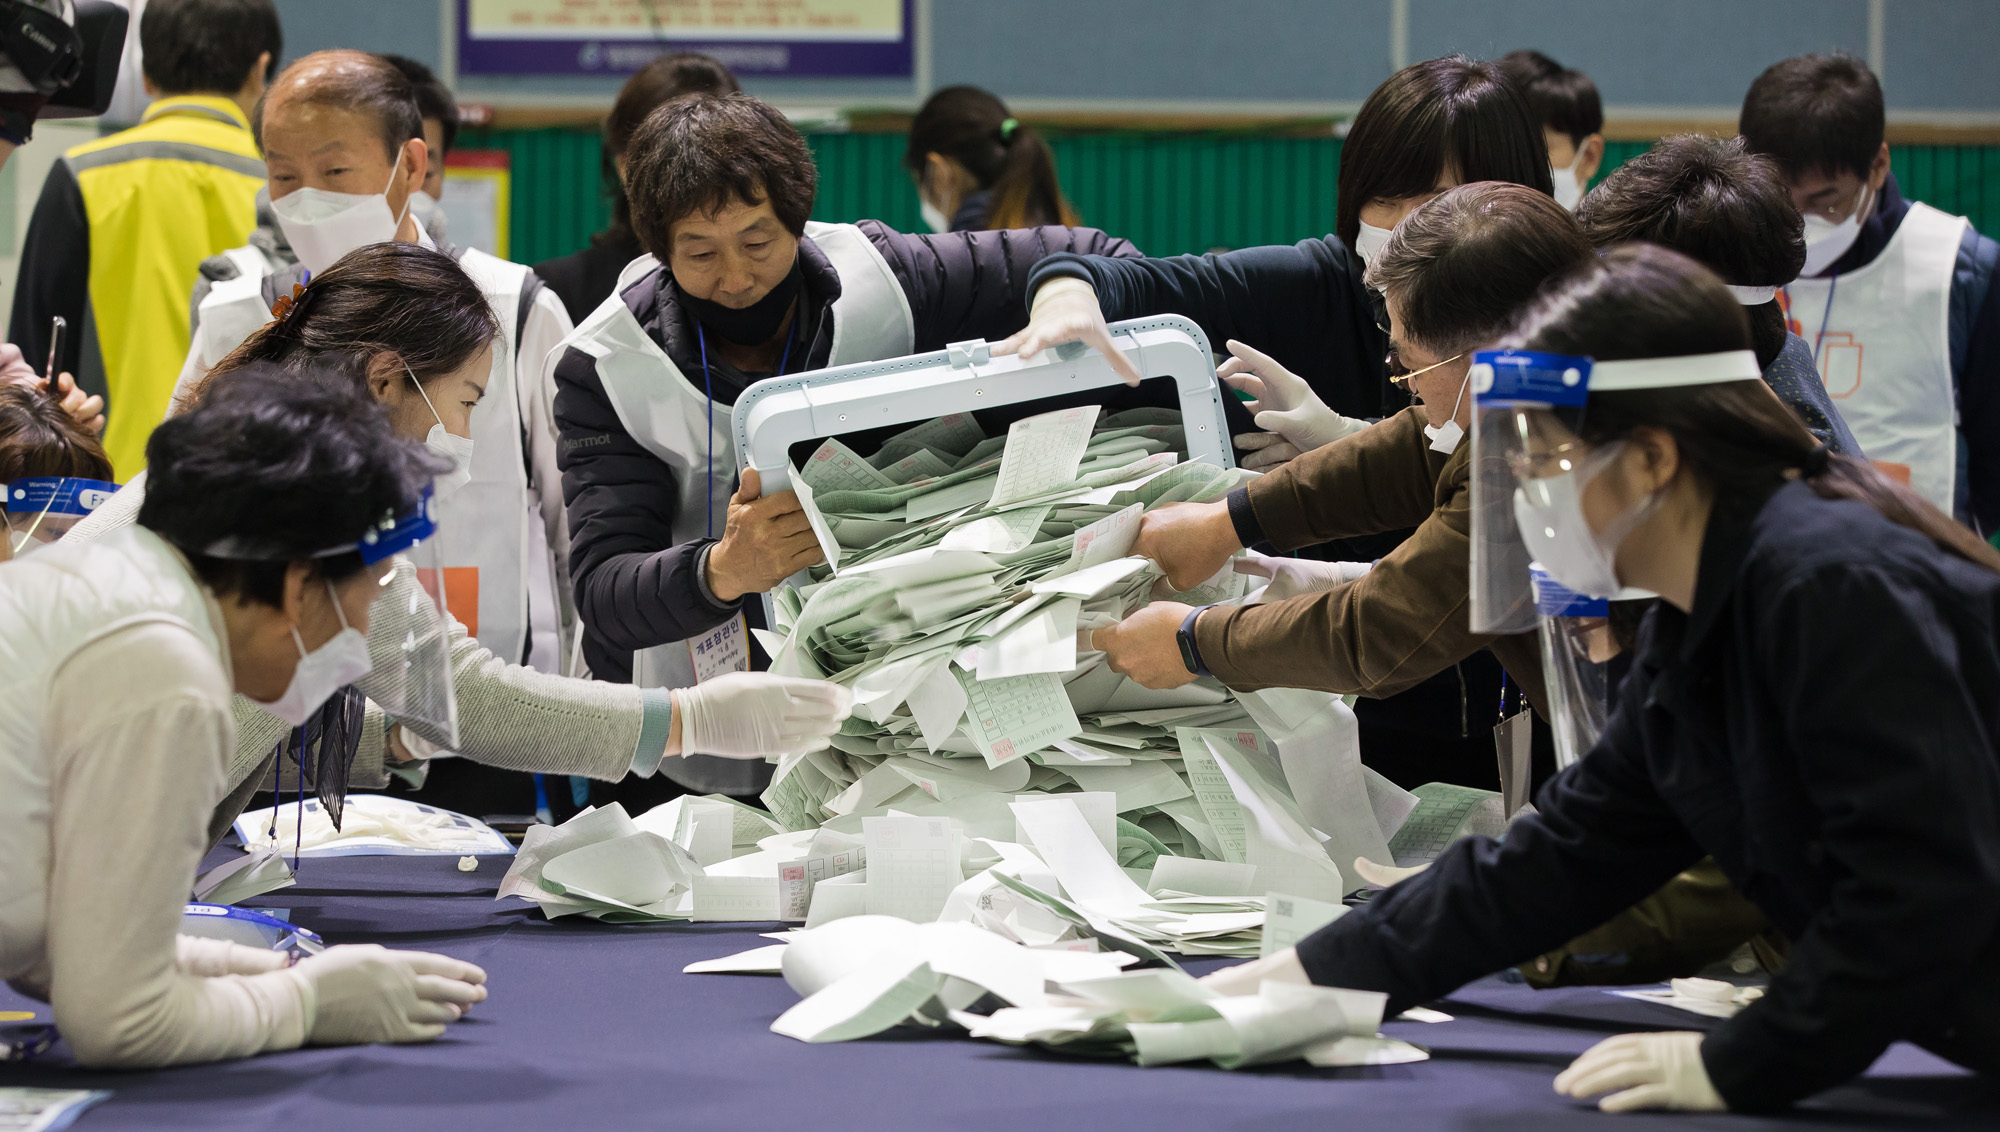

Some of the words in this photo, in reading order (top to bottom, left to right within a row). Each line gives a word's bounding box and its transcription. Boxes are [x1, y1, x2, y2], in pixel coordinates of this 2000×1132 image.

[22, 23, 56, 53] Canon
[564, 433, 611, 450] Marmot
[696, 619, 739, 655] 개표참관인
